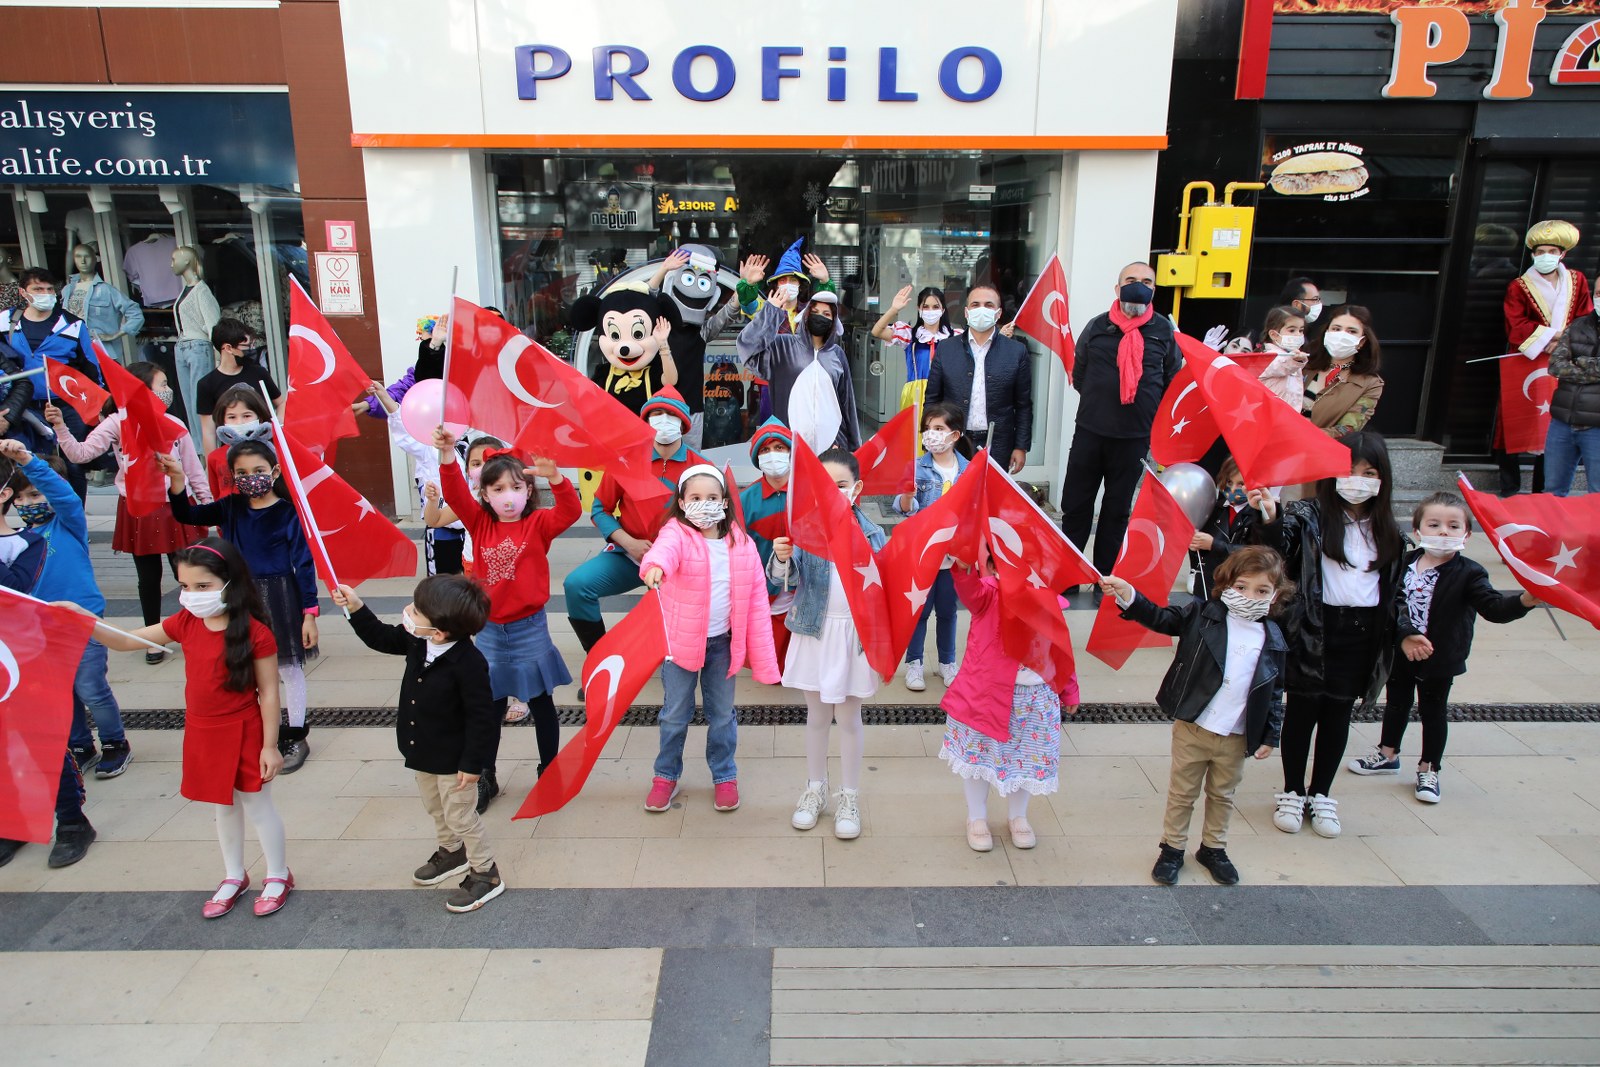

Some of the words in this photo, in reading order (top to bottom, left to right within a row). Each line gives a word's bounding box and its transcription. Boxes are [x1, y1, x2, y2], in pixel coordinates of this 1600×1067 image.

[0, 99, 156, 137] alışveriş
[1293, 142, 1326, 154] YAPRAK
[1326, 141, 1338, 151] ET
[1338, 142, 1364, 155] DÖNER
[0, 147, 212, 176] alife.com.tr
[329, 286, 351, 294] KAN
